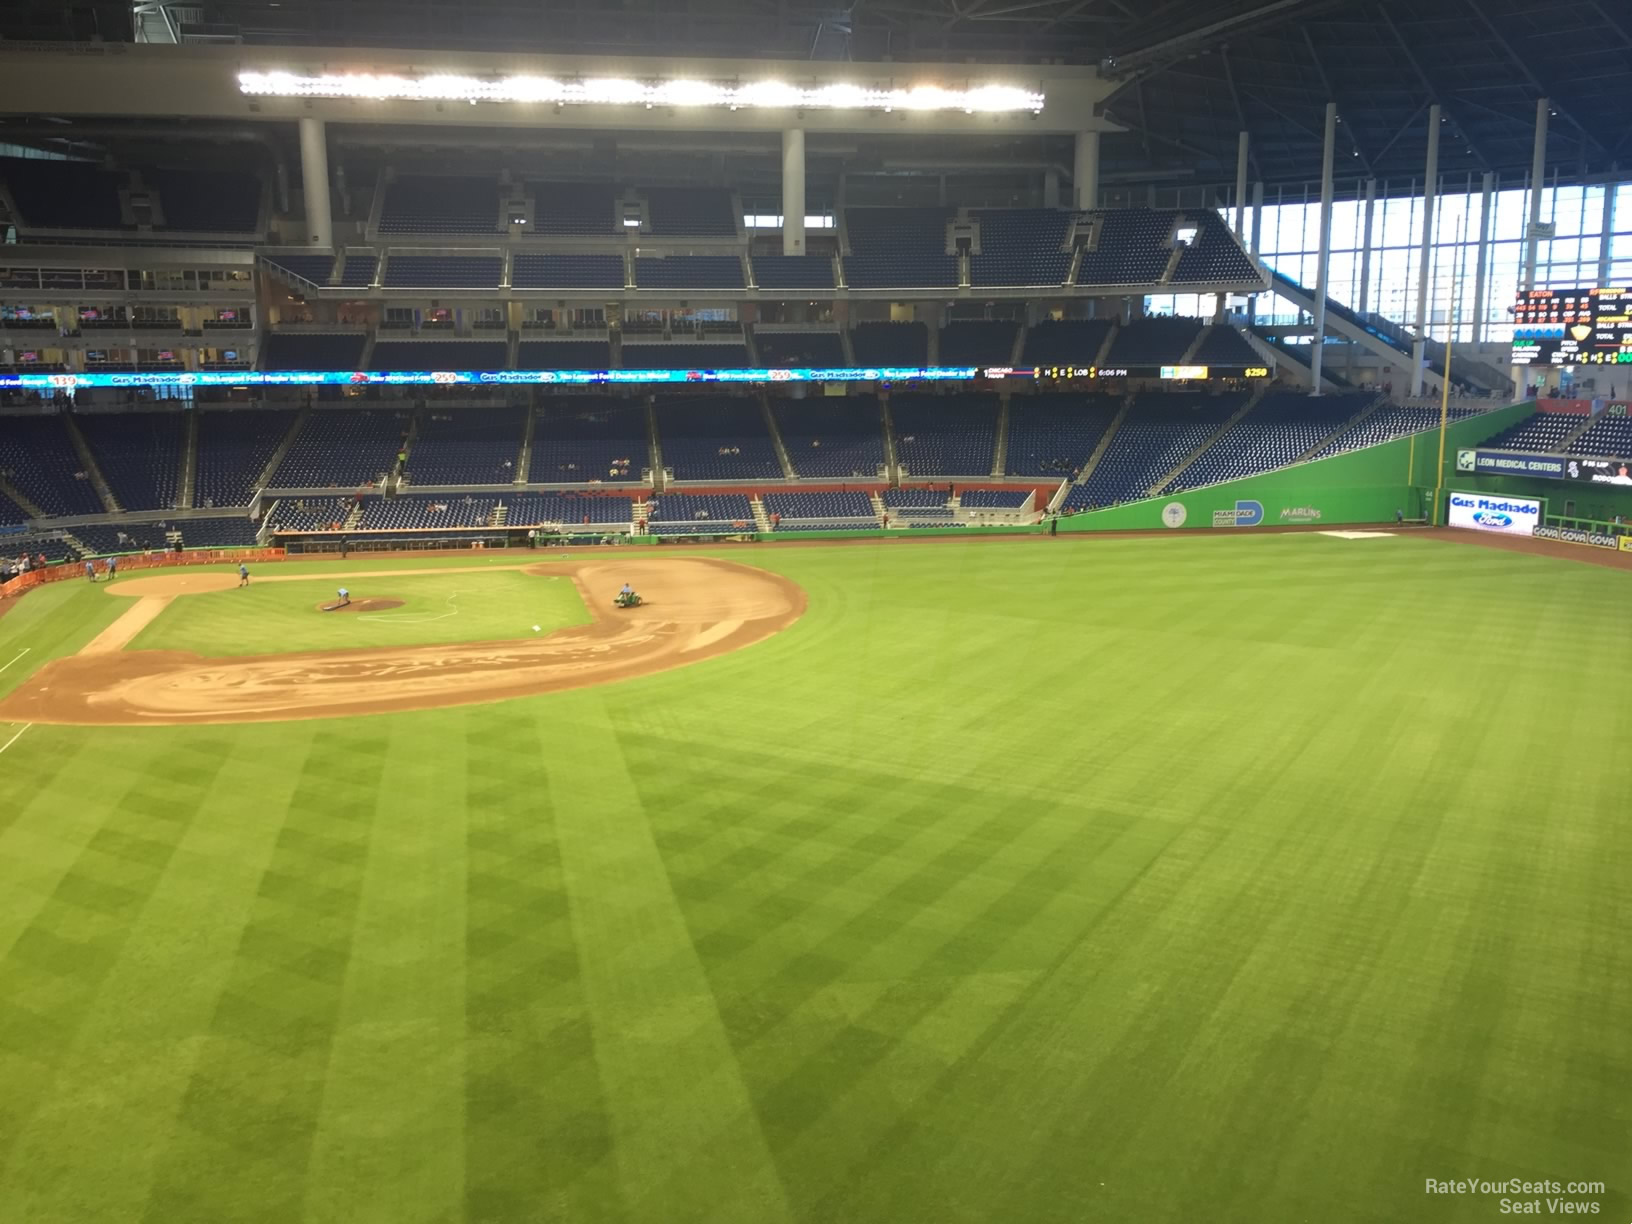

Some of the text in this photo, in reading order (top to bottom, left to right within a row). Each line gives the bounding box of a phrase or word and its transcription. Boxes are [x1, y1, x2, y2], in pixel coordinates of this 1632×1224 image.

[1245, 368, 1267, 377] $250
[53, 377, 76, 385] 139
[1608, 405, 1627, 415] 401
[1477, 458, 1562, 472] LEON MEDICAL CENTERS
[1452, 497, 1538, 514] Gus Machado
[1478, 512, 1506, 526] Ford
[1534, 527, 1558, 538] GOYA
[1561, 531, 1586, 542] GOYA
[1590, 534, 1616, 547] GOYA
